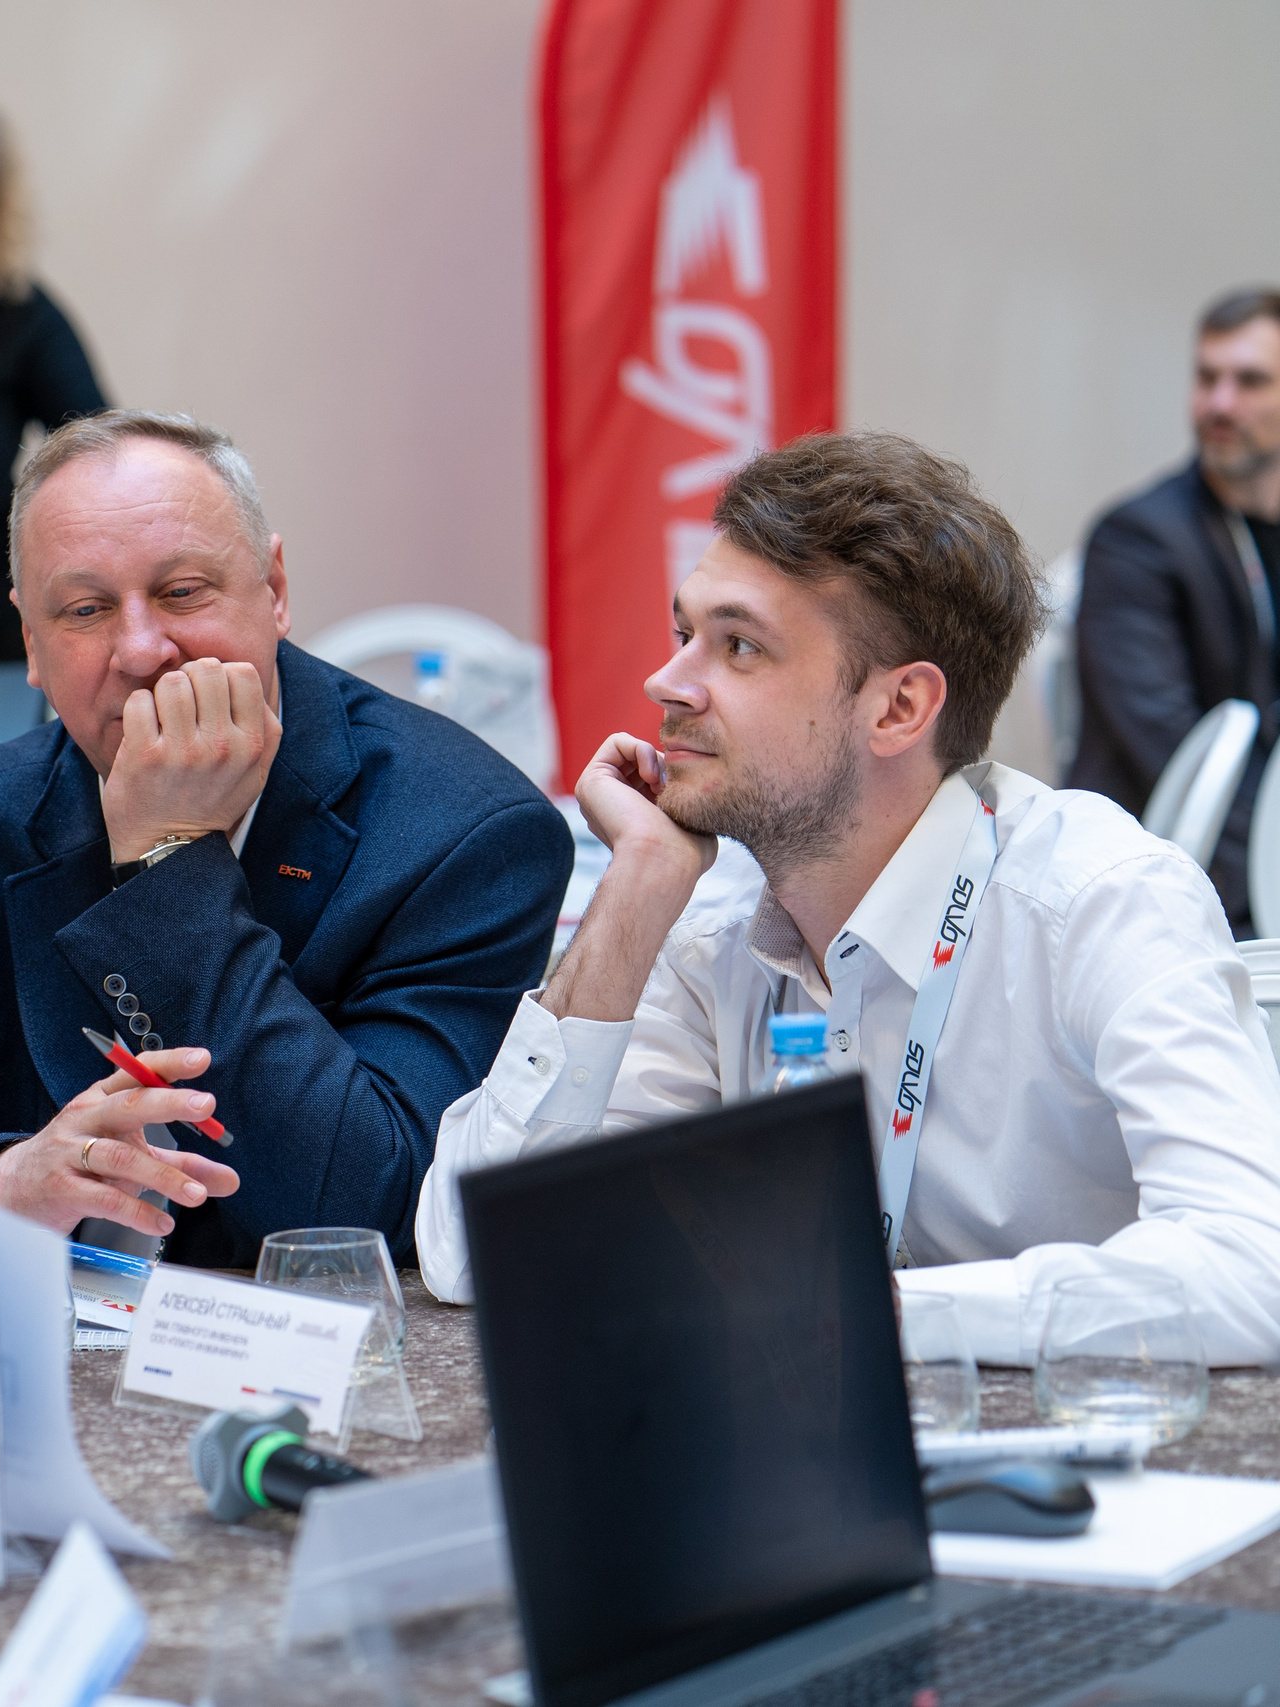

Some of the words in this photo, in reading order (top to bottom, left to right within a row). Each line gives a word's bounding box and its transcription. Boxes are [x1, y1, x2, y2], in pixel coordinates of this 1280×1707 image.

[941, 874, 974, 944] SOLVO
[898, 1039, 925, 1112] SOLVO
[159, 1291, 216, 1316] АЛЕКСЕЙ
[215, 1301, 291, 1332] СТРАШНЫЙ
